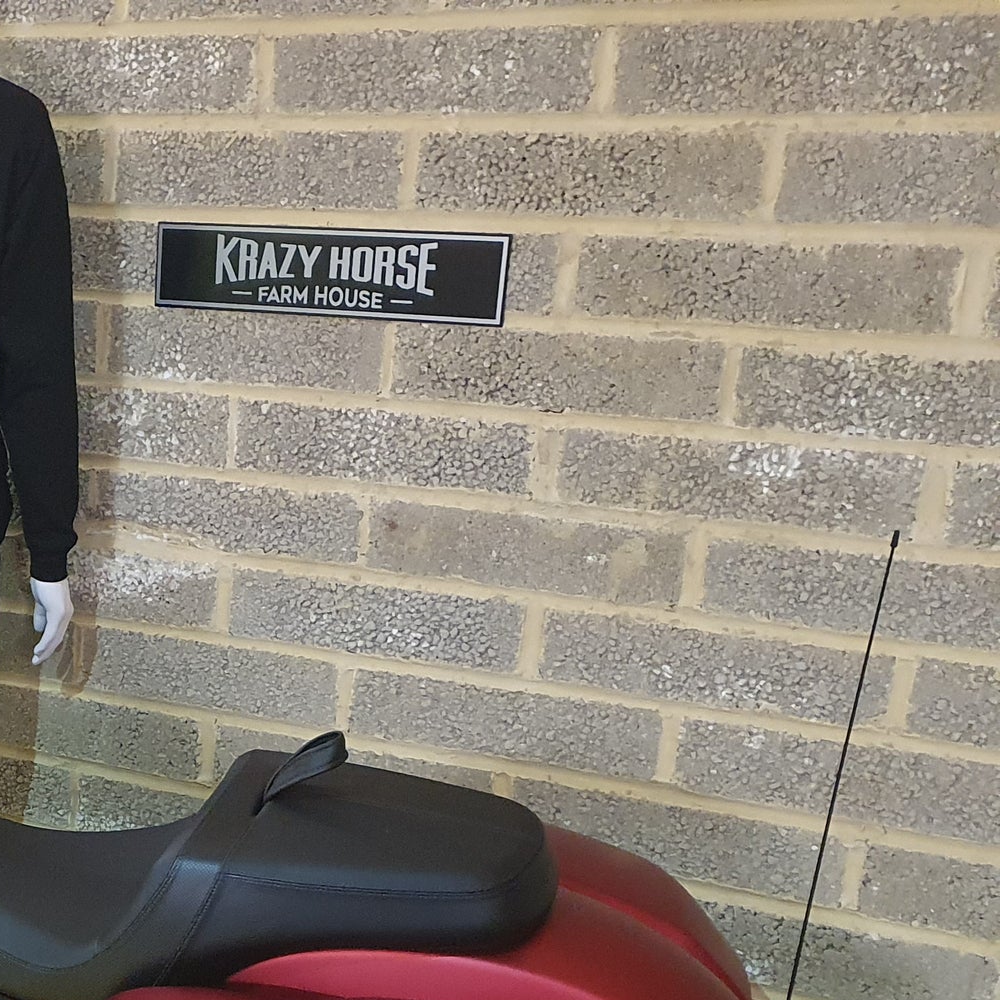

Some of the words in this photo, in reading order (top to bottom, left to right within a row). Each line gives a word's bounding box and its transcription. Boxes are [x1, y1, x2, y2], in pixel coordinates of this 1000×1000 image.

[215, 233, 323, 285] KRAZY
[328, 241, 439, 297] HORSE
[257, 285, 309, 304] FARM
[313, 286, 384, 310] HOUSE
